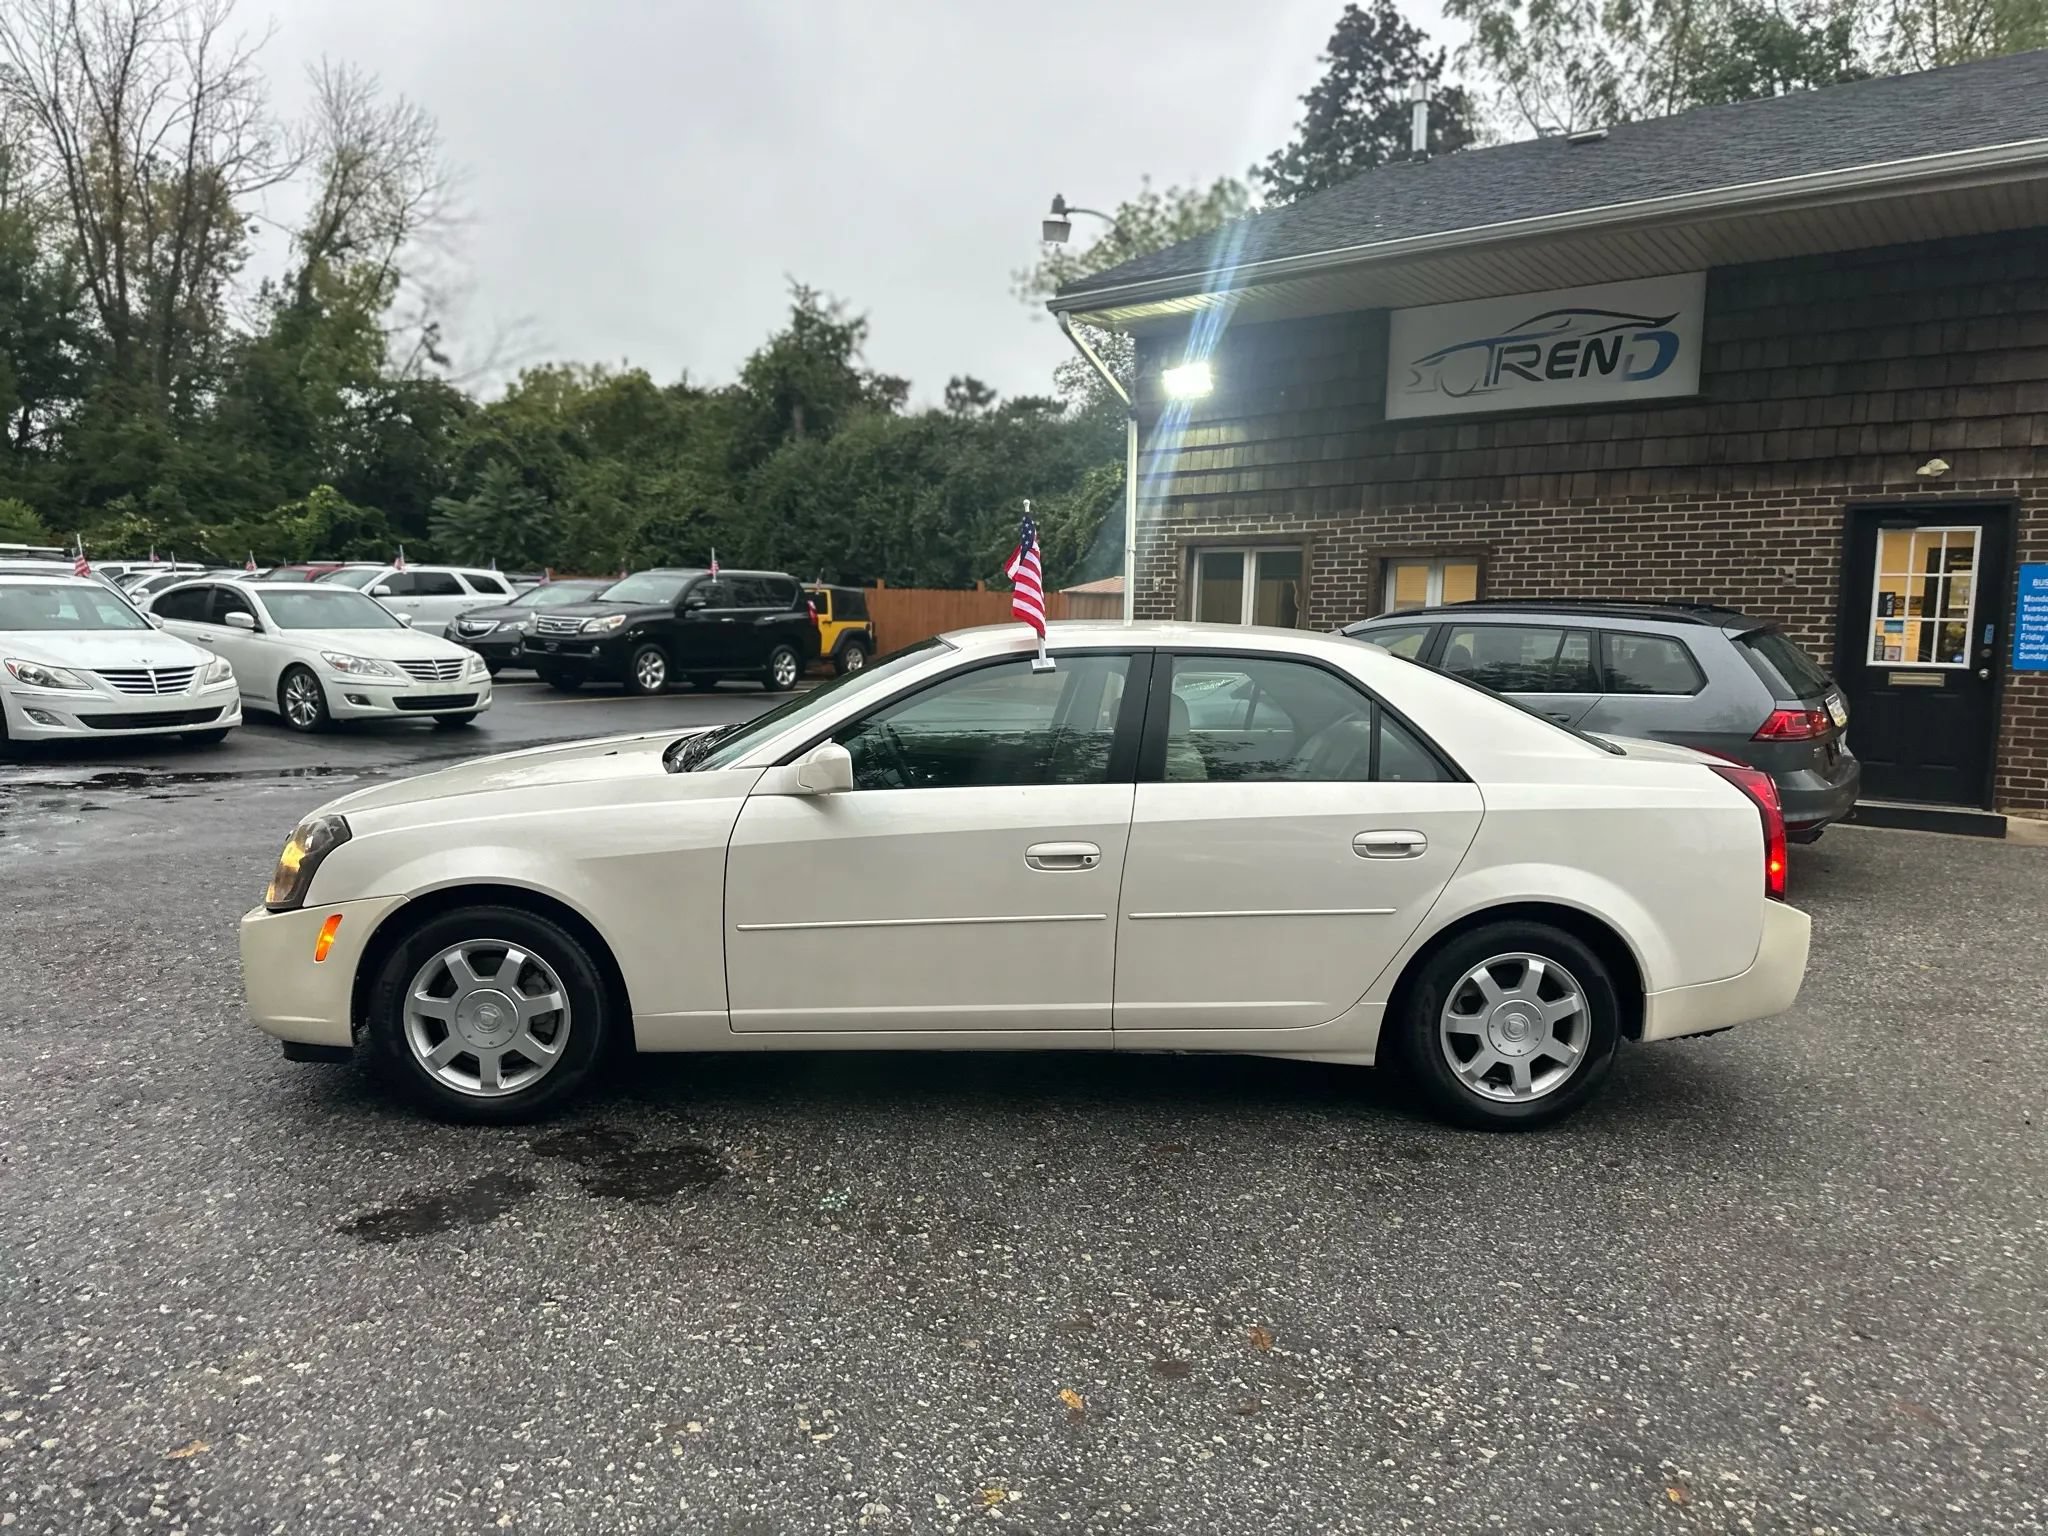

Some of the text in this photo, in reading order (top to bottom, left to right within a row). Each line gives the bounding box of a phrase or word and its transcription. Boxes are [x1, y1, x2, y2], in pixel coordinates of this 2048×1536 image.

[1483, 331, 1680, 387] TREND
[2020, 633, 2045, 643] Friday
[2018, 652, 2048, 662] Sunday
